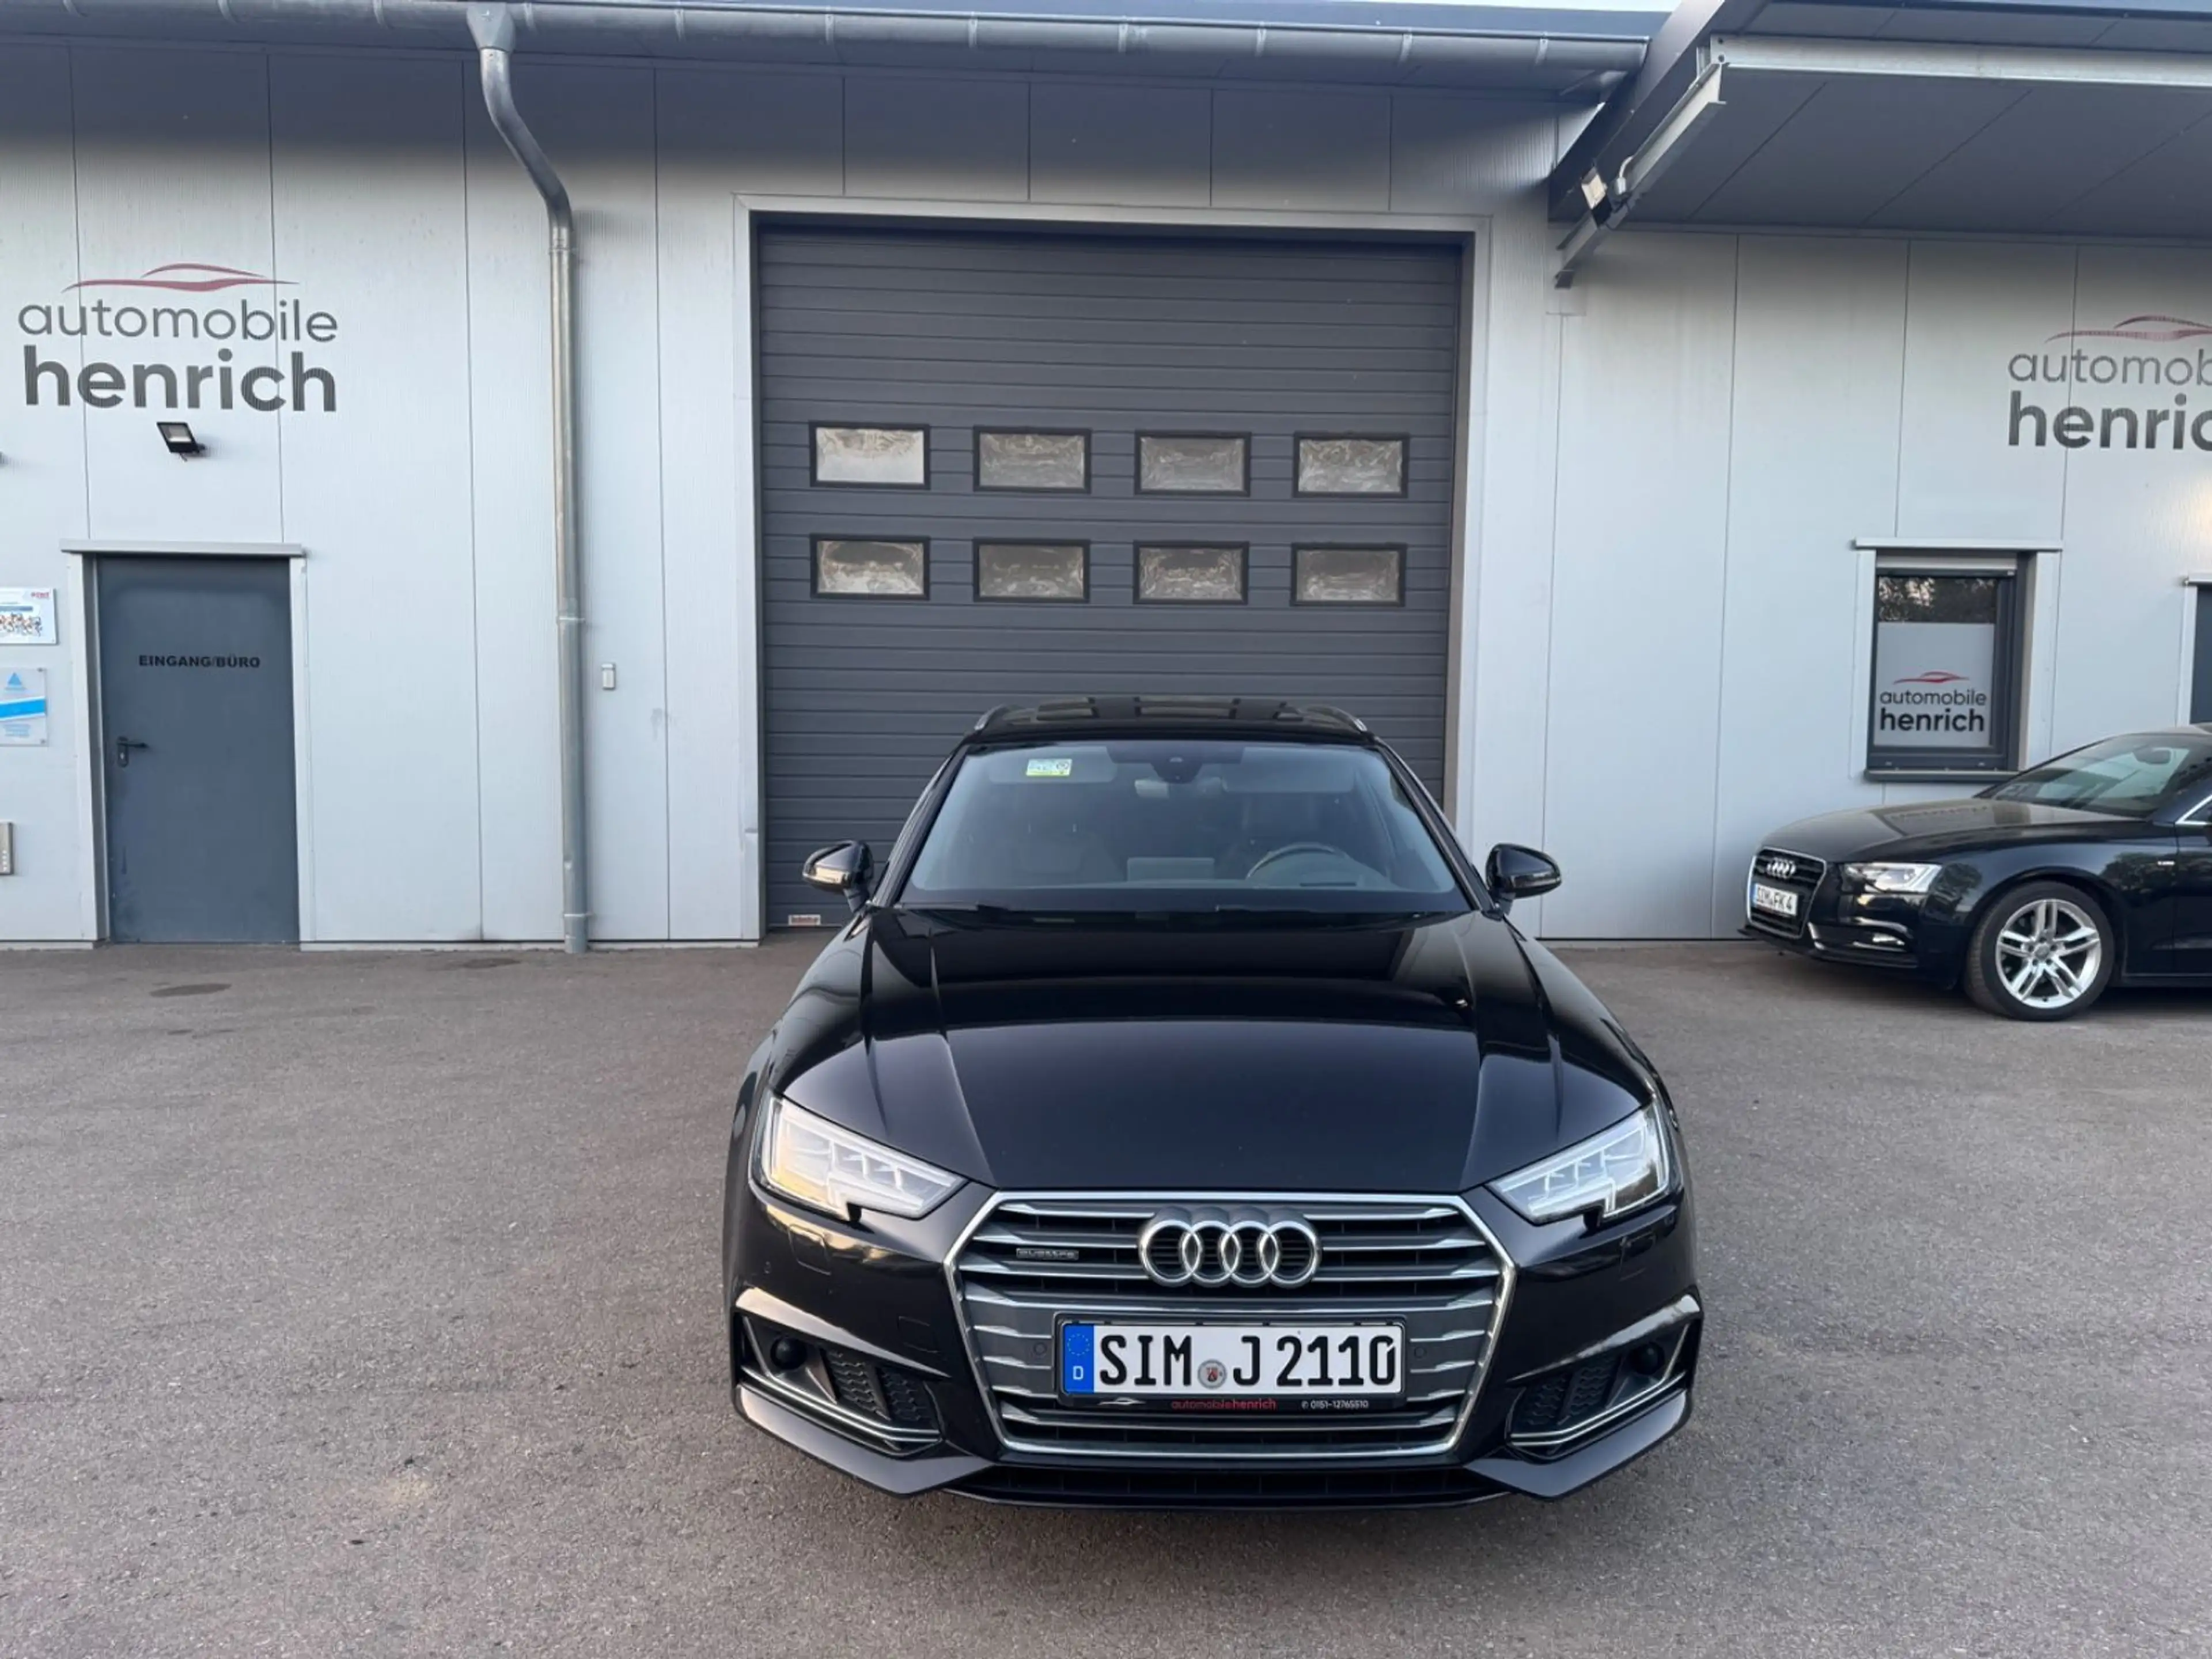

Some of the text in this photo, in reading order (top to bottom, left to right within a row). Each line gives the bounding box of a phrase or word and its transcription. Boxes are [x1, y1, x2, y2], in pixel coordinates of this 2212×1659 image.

[18, 299, 338, 342] automobile
[24, 345, 337, 412] henrich
[139, 653, 260, 668] EINGANG/BÜRO
[1880, 690, 1987, 706] automobile
[1880, 707, 1984, 732] henrich
[1073, 1366, 1084, 1380] D
[1100, 1335, 1396, 1387] SIM J 2110
